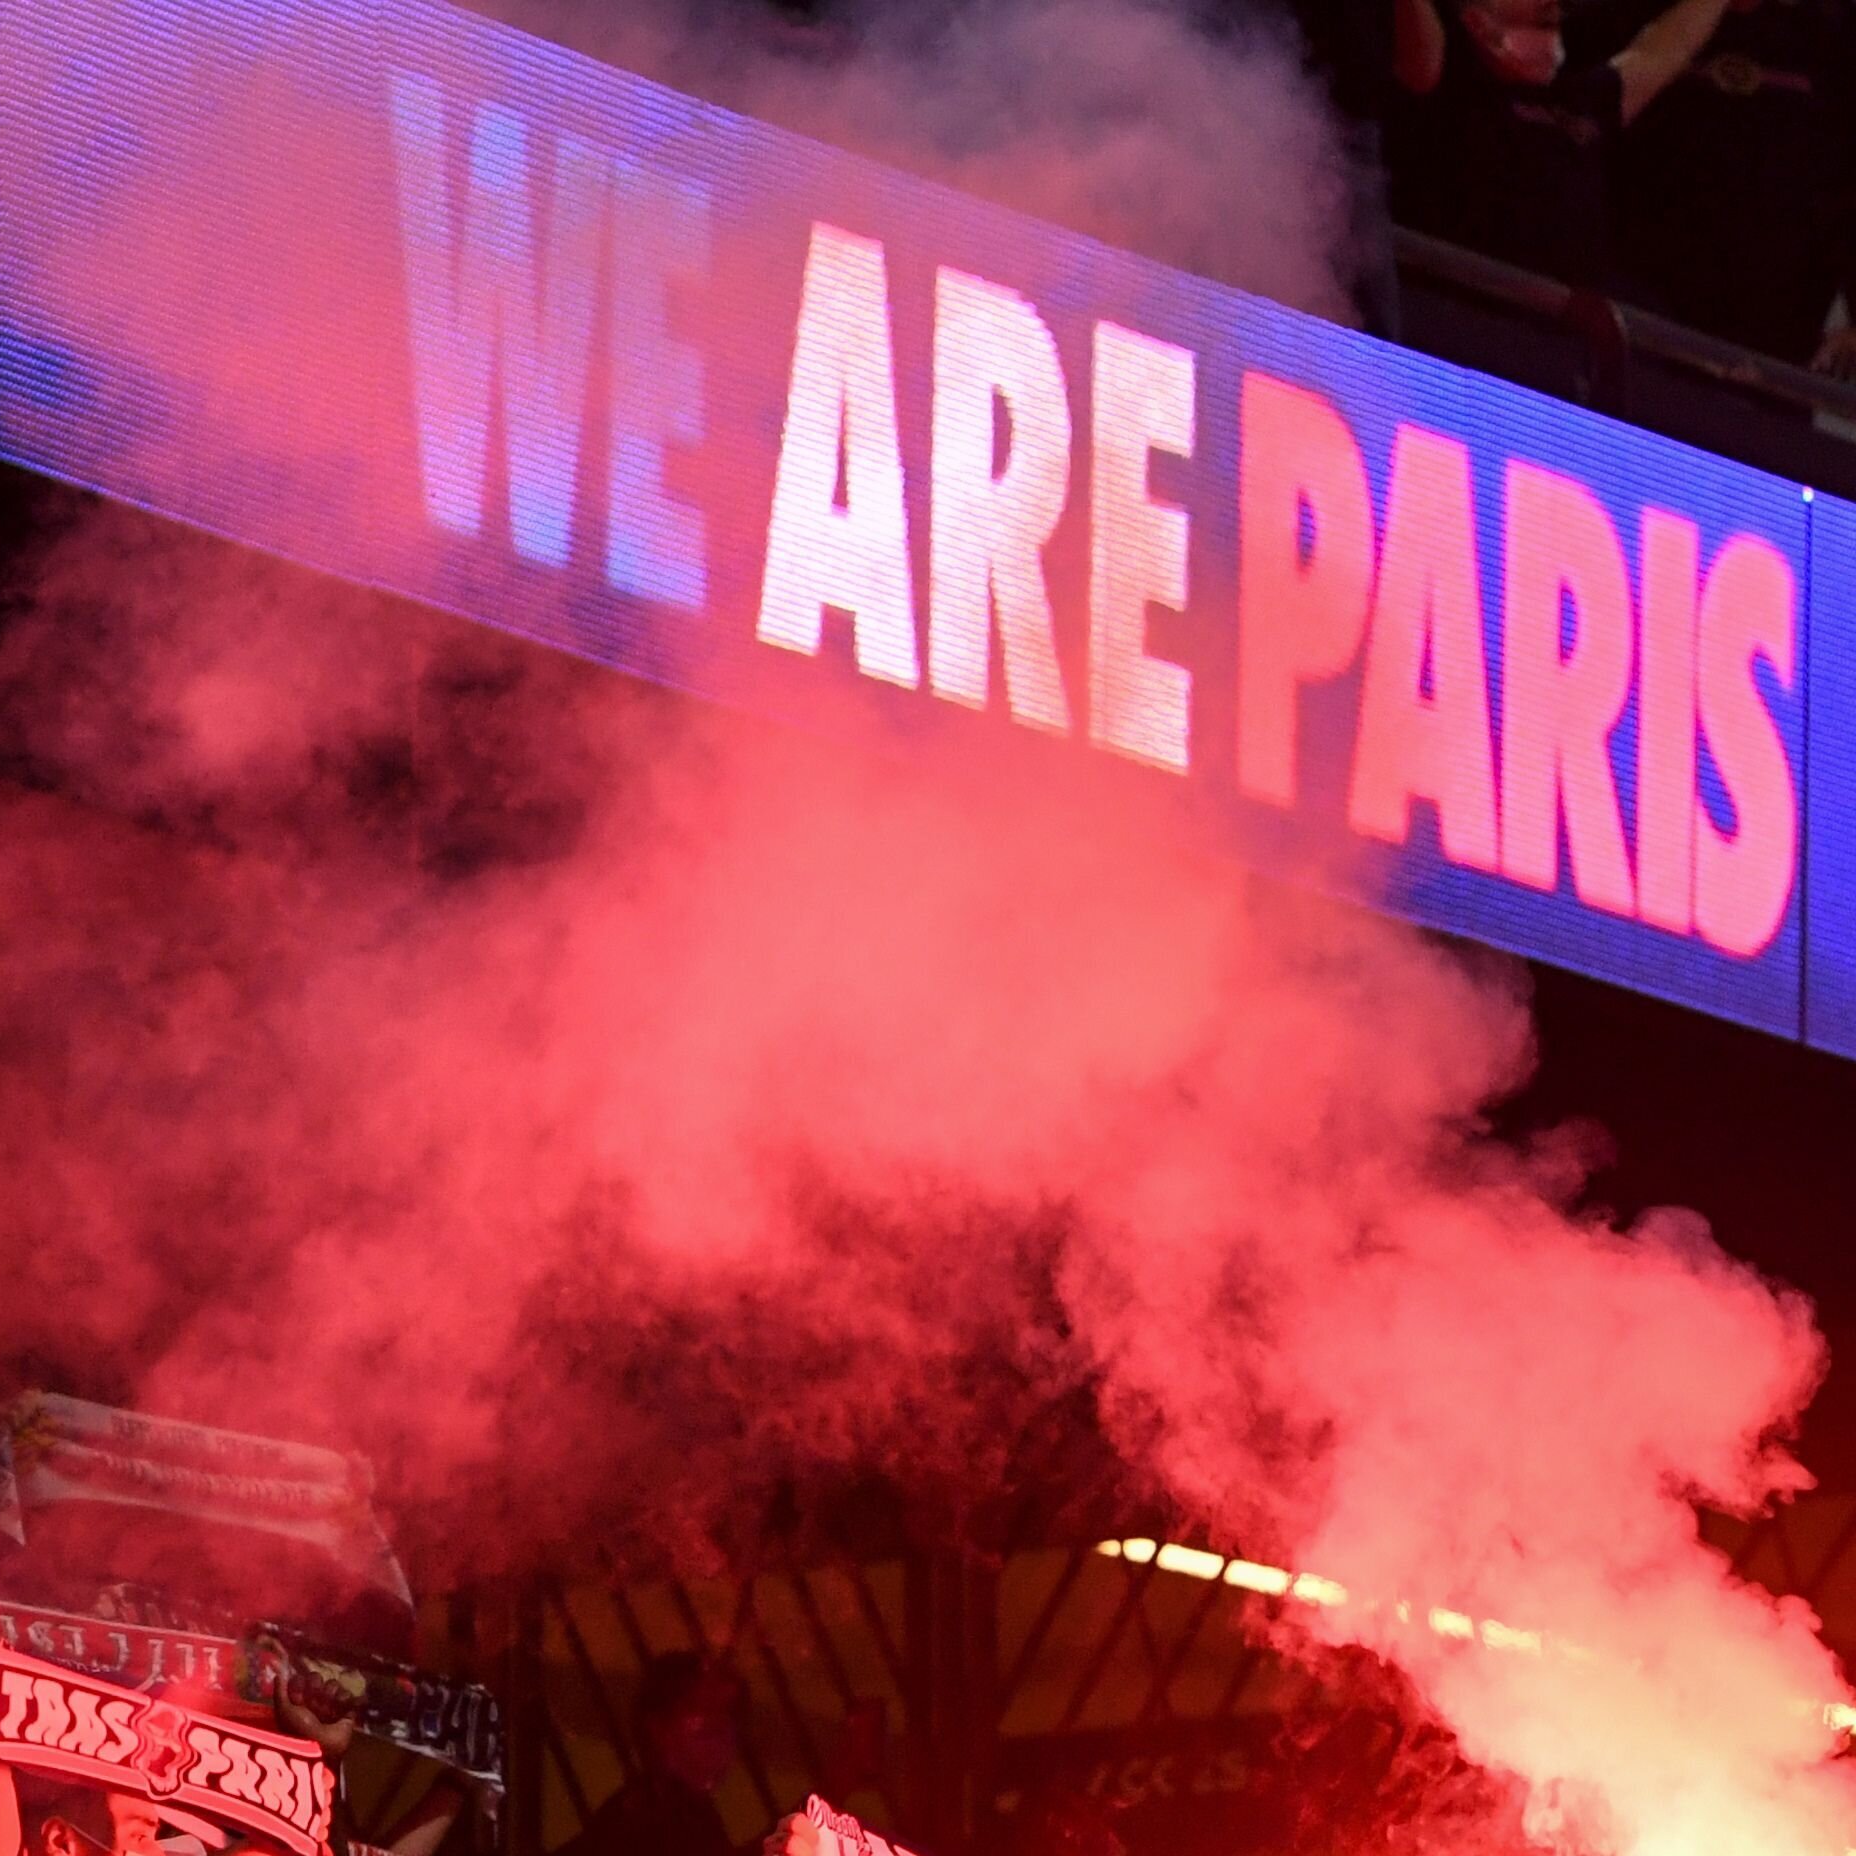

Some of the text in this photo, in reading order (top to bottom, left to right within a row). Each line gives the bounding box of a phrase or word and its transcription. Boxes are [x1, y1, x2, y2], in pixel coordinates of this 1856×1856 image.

[391, 66, 710, 610] WE
[755, 220, 1198, 776] ARE
[1239, 370, 1799, 960] PARIS
